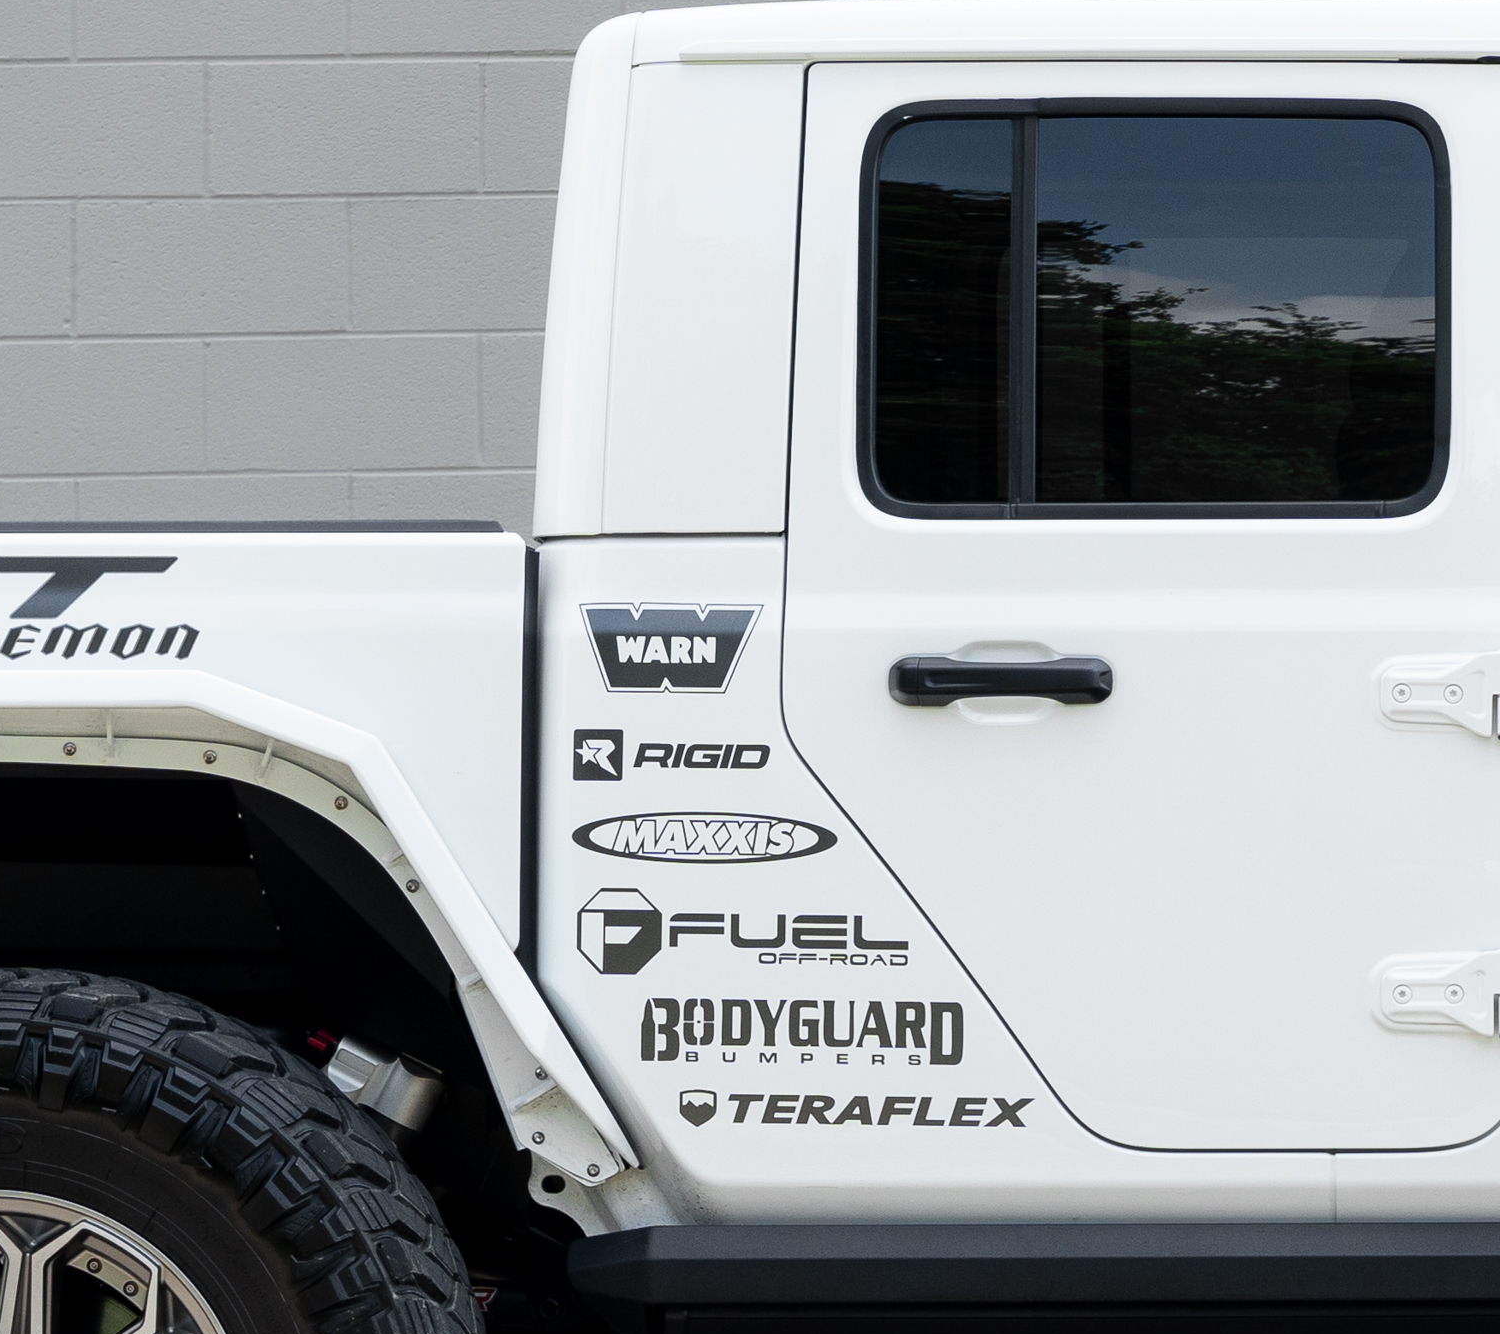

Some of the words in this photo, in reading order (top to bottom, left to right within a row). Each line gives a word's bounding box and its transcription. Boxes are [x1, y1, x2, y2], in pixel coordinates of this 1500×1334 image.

[616, 636, 716, 664] WARN
[633, 743, 770, 770] RIGID
[612, 819, 797, 856] MAXXIS
[669, 913, 909, 950] FUEL
[758, 952, 908, 966] OFF-ROAD
[641, 998, 963, 1065] BODYGUARD
[686, 1051, 921, 1066] BUMPERS
[728, 1094, 1034, 1127] TERAFLEX
